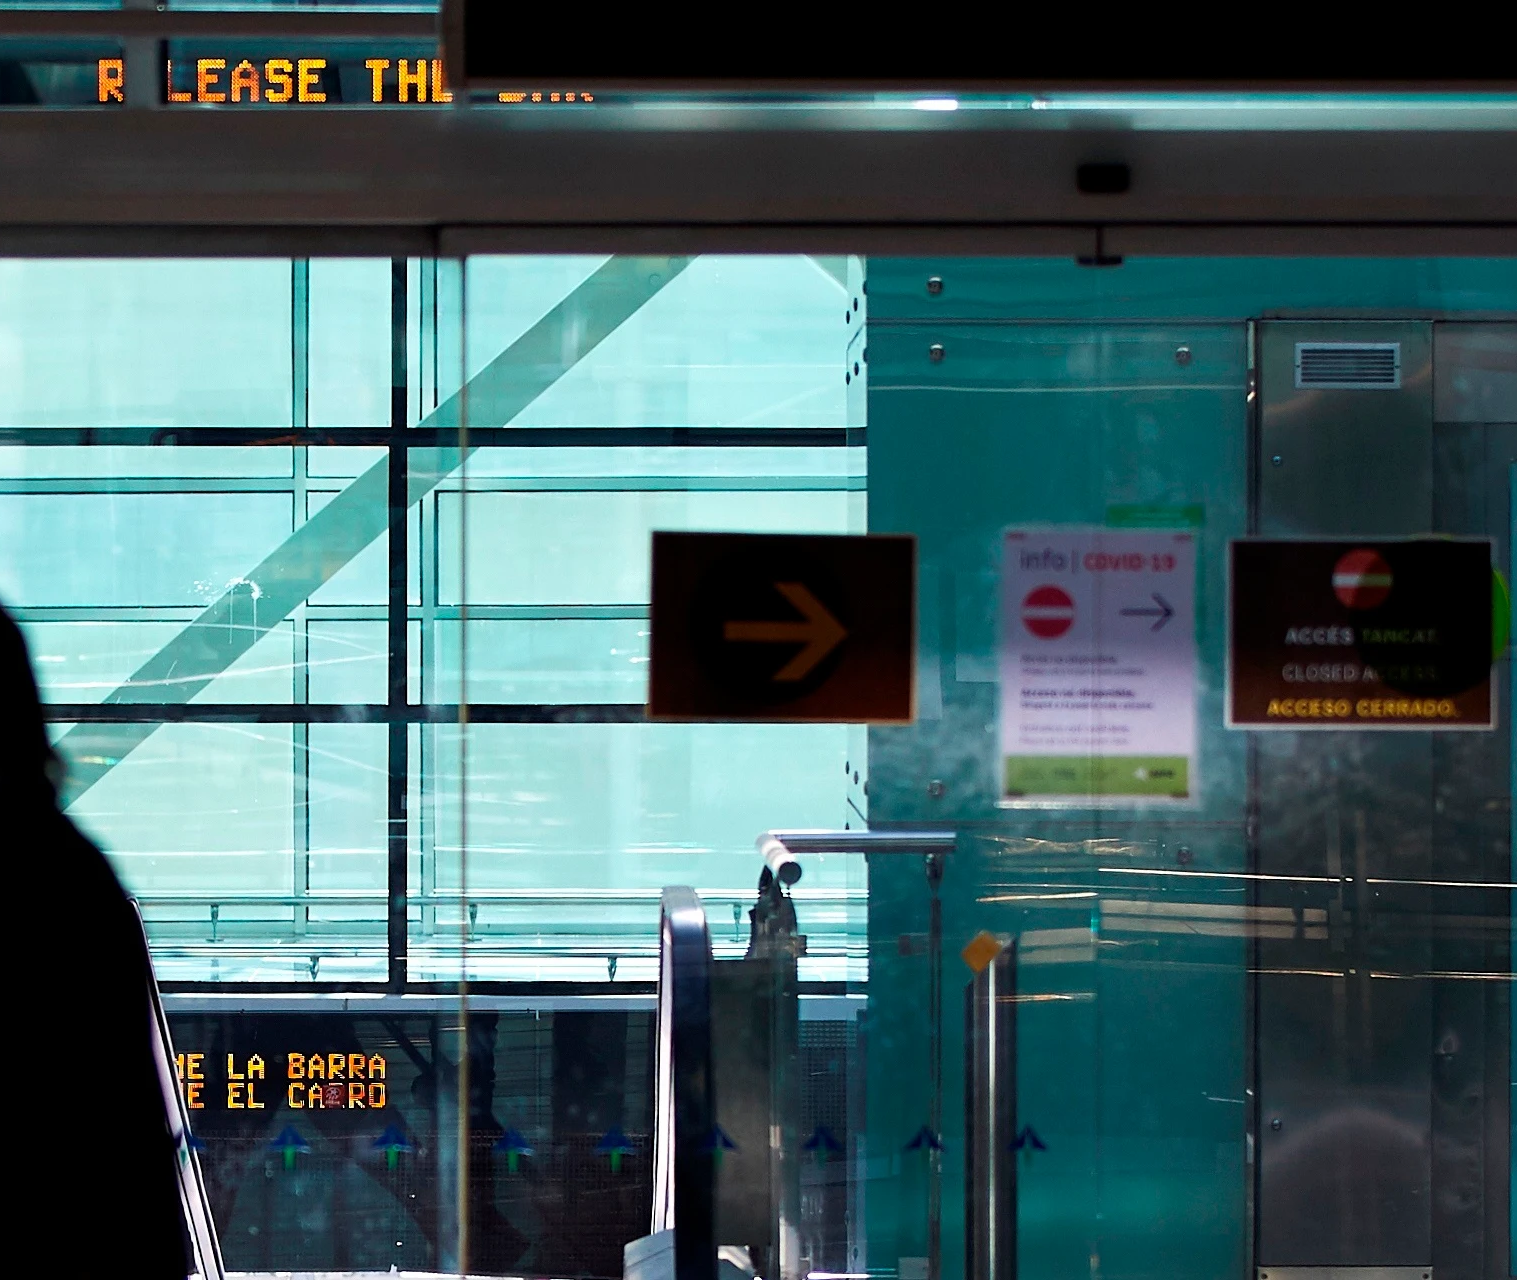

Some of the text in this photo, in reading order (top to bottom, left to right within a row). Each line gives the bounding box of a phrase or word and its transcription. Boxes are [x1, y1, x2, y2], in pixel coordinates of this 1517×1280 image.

[98, 59, 327, 103] RLEASE
[1281, 664, 1360, 683] CLOSED
[1266, 699, 1352, 719] ACCESO
[227, 1053, 265, 1080] LA
[288, 1053, 386, 1080] BARRA
[227, 1082, 265, 1109] EL
[288, 1082, 386, 1109] CARO
